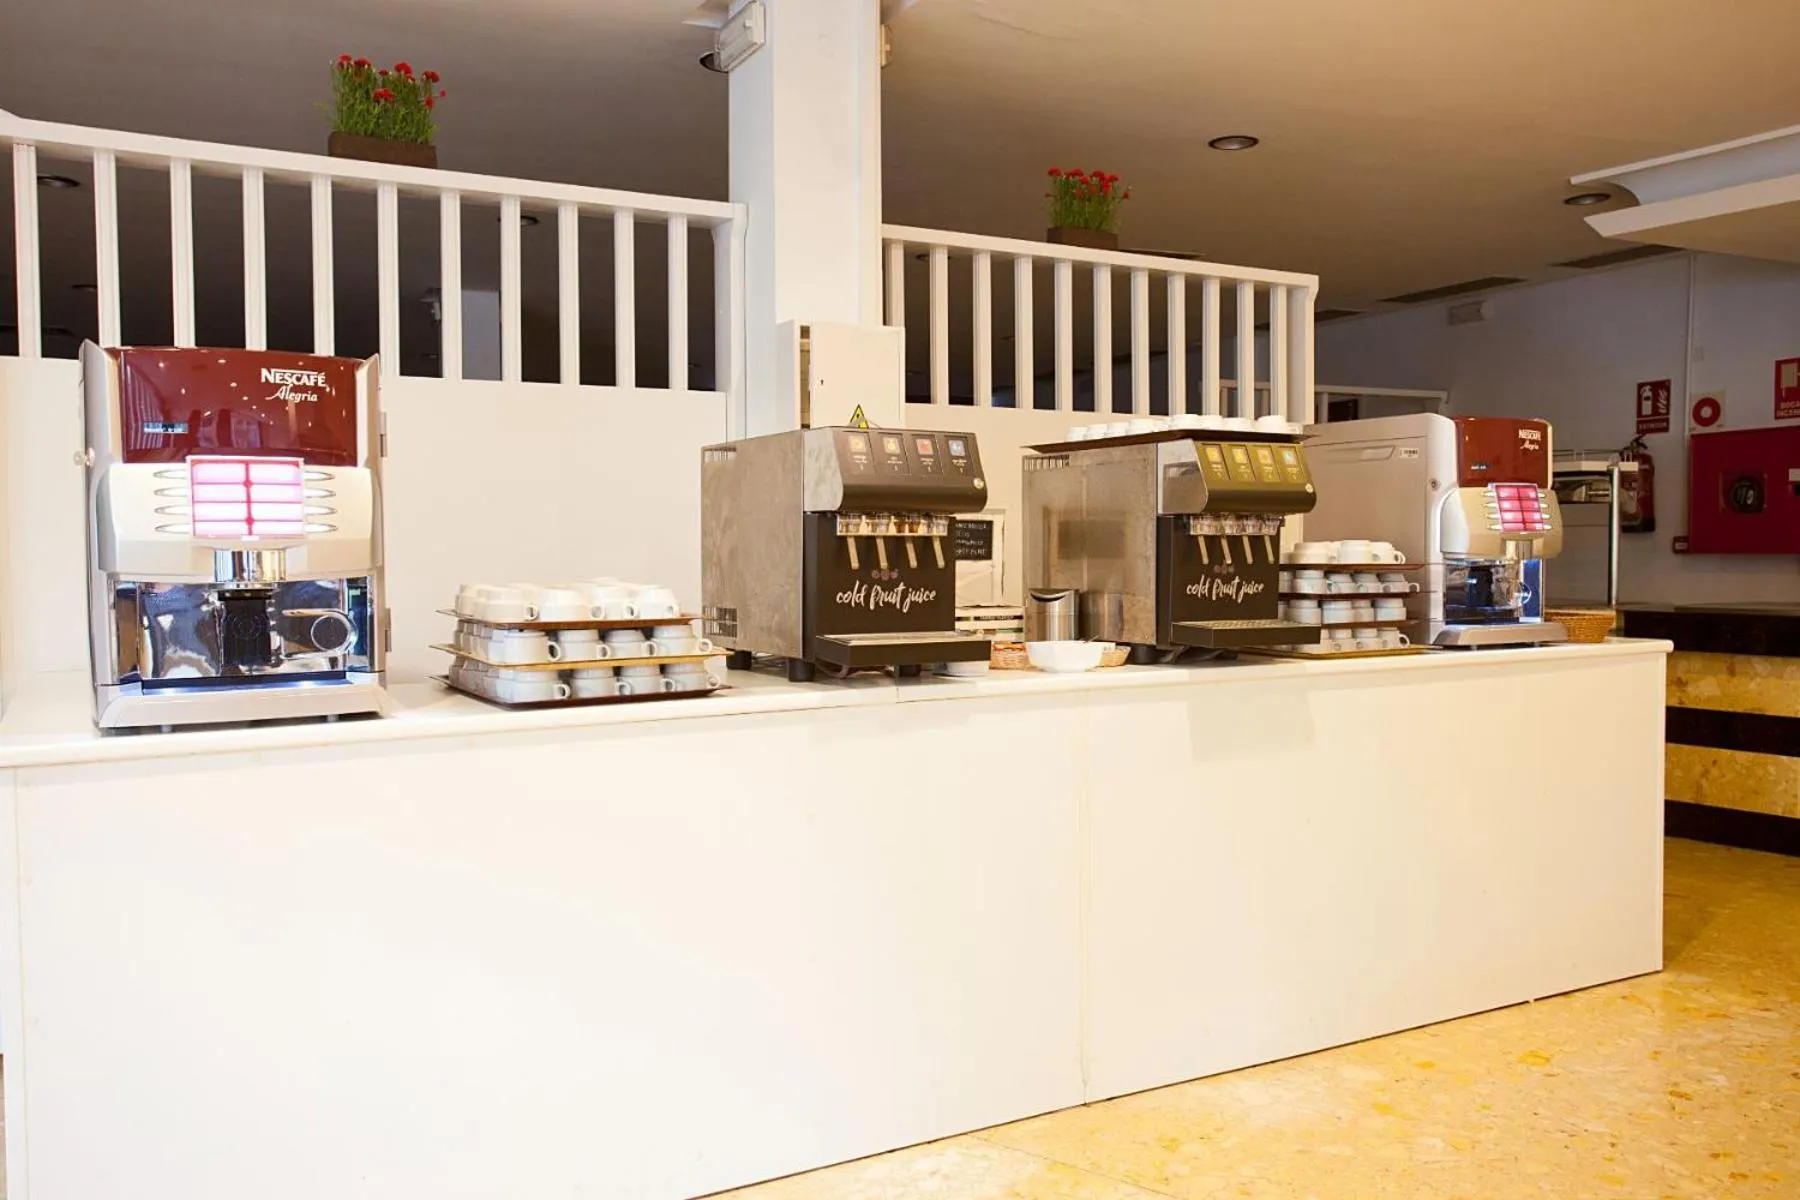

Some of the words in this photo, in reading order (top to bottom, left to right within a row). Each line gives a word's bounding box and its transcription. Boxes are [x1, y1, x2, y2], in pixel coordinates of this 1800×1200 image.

[261, 368, 326, 387] NESCAFÉ
[265, 384, 318, 403] Alegria
[836, 579, 868, 607] cold
[869, 581, 906, 610] fruit
[902, 587, 937, 613] juice
[1186, 574, 1211, 599] cold
[1212, 575, 1240, 601] fruit
[1237, 580, 1265, 604] juice
